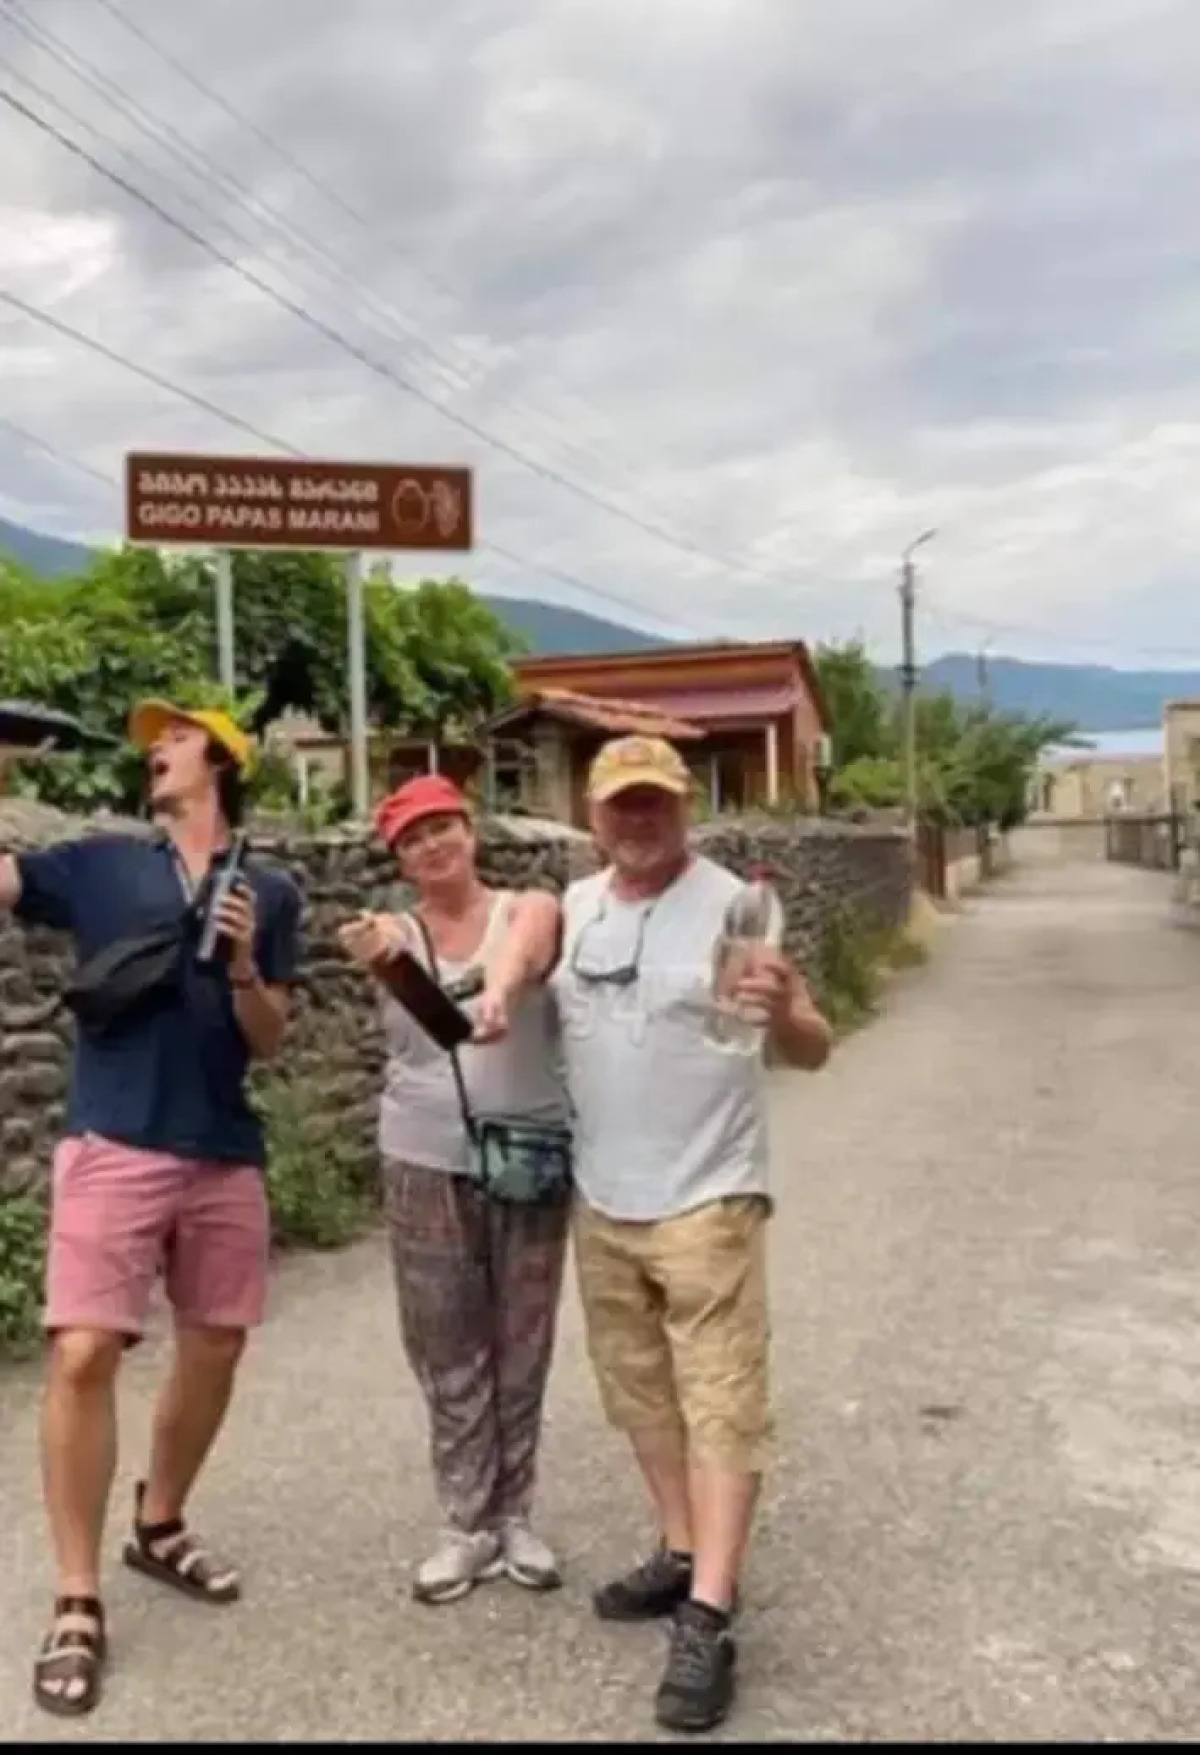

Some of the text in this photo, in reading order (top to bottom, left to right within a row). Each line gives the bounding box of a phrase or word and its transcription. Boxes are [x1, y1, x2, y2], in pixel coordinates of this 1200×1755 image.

[138, 502, 380, 532] GIGO PAPAS MARANI
